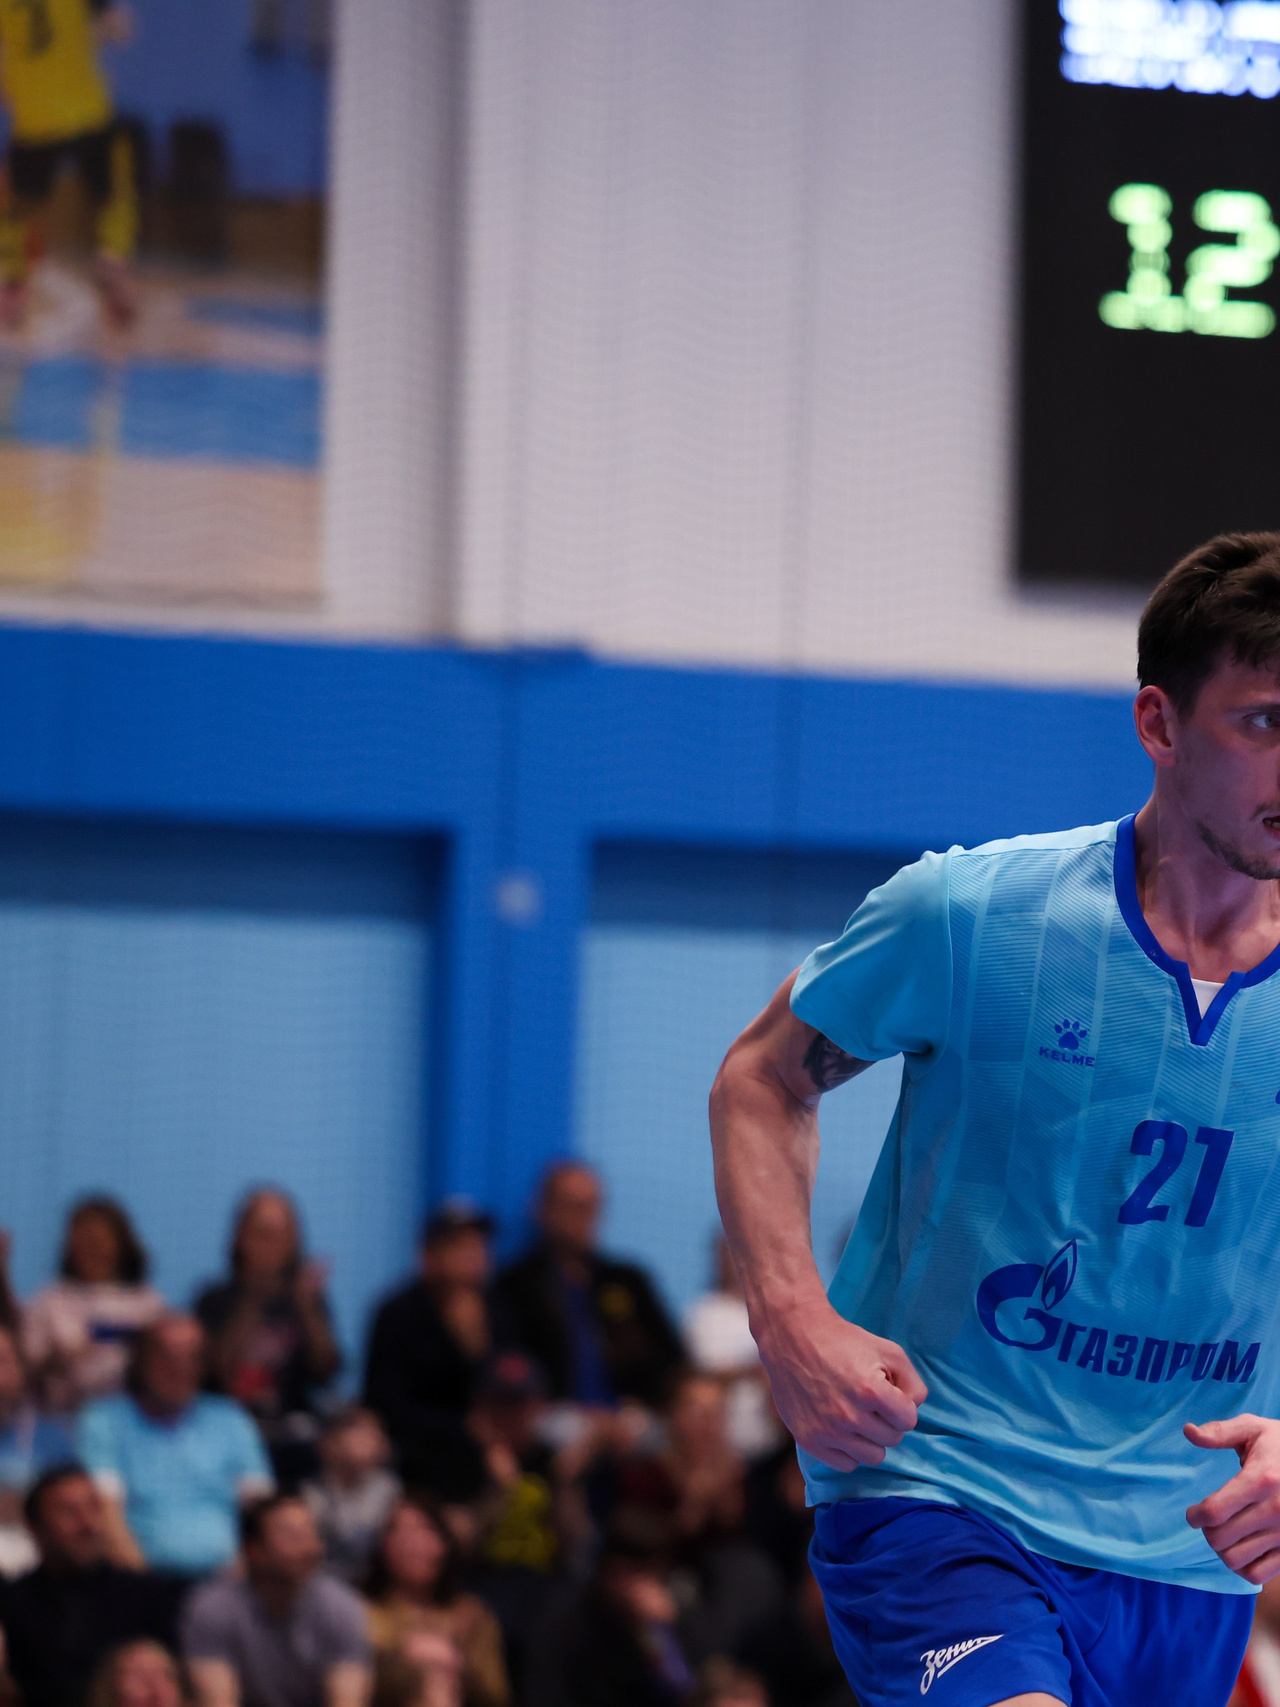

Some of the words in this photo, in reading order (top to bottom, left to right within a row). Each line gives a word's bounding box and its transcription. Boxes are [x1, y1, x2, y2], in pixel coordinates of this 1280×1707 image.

[1038, 1046, 1096, 1068] KELME
[1117, 1119, 1235, 1228] 21
[1056, 1321, 1261, 1384] ГАЗПРОМ
